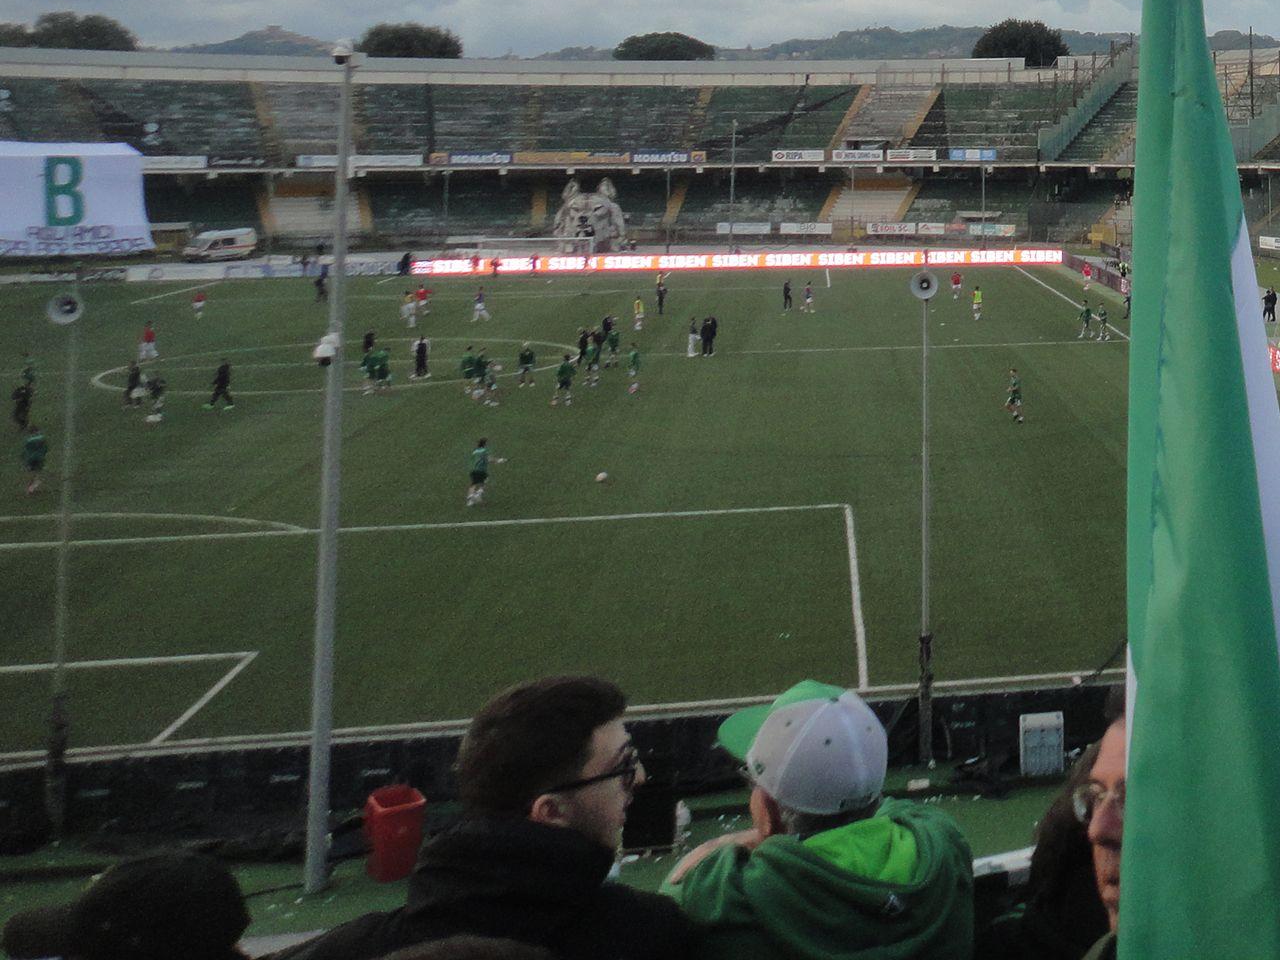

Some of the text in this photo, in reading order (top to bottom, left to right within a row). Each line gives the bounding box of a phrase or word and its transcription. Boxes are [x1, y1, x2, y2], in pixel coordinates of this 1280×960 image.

[450, 152, 511, 164] KOMATSU
[633, 152, 688, 163] KOMATSU
[785, 152, 803, 160] RIPA
[44, 156, 84, 227] B
[604, 255, 653, 269] SIBEN
[658, 255, 707, 269] SIBEN
[711, 254, 759, 268] SIBEN
[765, 253, 811, 267] SIBEN
[818, 253, 865, 266] SIBEN
[870, 252, 917, 266] SIBEN
[970, 250, 1015, 263] SIBEN
[1020, 250, 1063, 263] SIBEN
